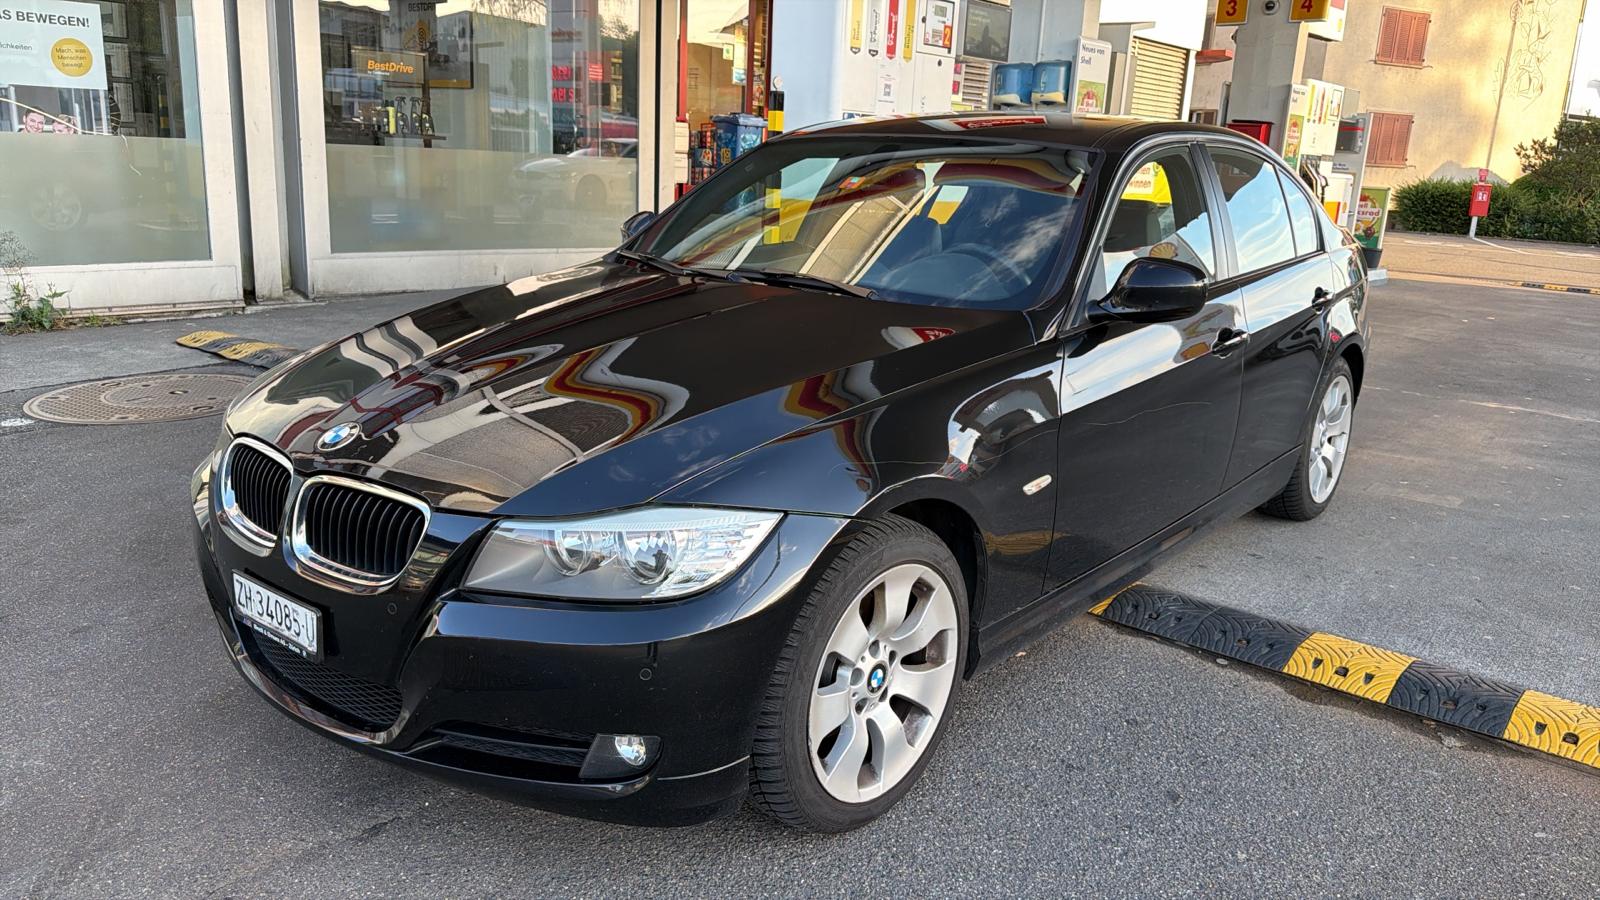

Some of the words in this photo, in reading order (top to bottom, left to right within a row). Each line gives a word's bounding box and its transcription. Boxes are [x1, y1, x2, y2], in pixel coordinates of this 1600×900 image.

[1225, 0, 1237, 16] 3
[1301, 0, 1313, 13] 4
[0, 9, 12, 20] S
[16, 11, 90, 28] BEWEGEN!
[944, 26, 952, 46] 2
[1082, 44, 1096, 54] Neues
[367, 59, 414, 74] BestDrive
[1080, 56, 1092, 65] Shell
